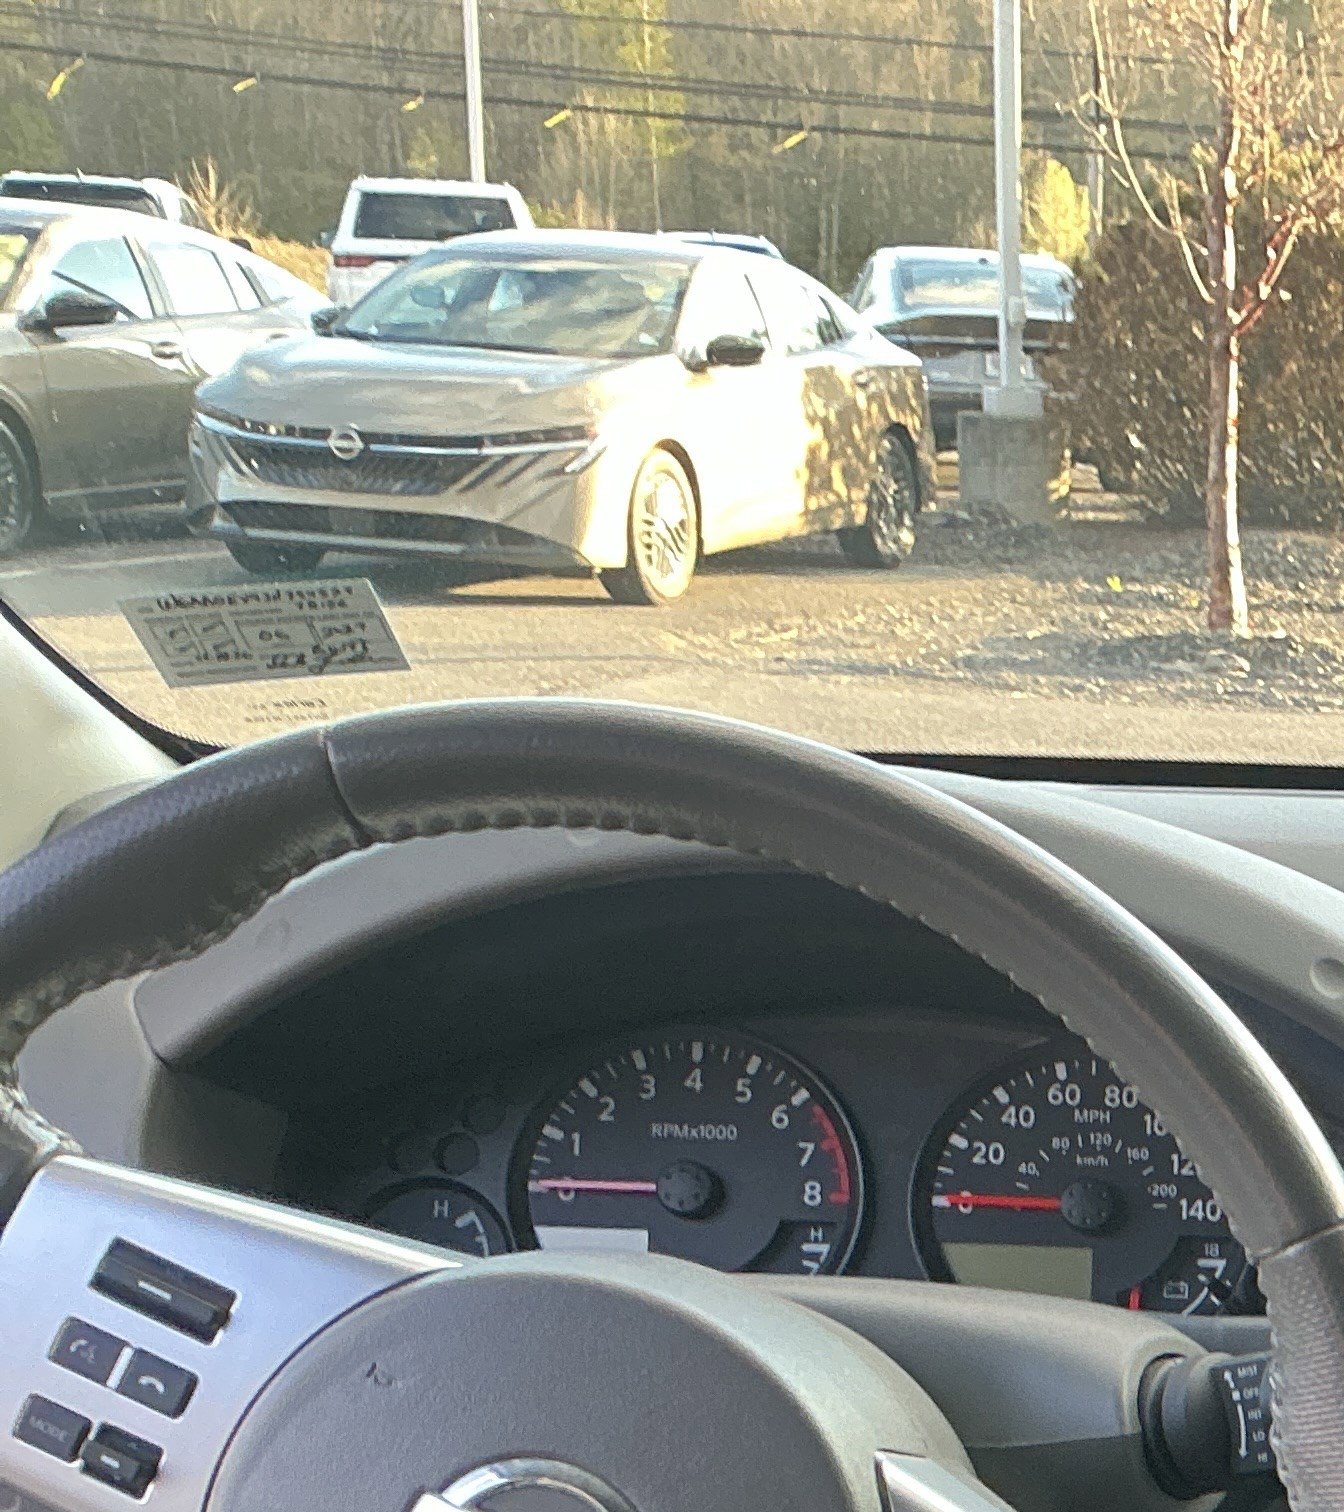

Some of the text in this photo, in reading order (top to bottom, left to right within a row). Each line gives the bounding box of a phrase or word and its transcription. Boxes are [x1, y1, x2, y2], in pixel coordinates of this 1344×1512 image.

[639, 1075, 657, 1100] 3
[685, 1069, 704, 1093] 4
[735, 1078, 752, 1103] 5
[1047, 1083, 1081, 1107] 60
[1103, 1085, 1139, 1108] 80
[598, 1098, 616, 1122] 2
[771, 1104, 790, 1130] 6
[1000, 1104, 1035, 1130] 40
[1073, 1108, 1111, 1124] MPH
[650, 1122, 739, 1142] RPMx1000
[1051, 1136, 1071, 1151] 80
[1088, 1133, 1112, 1147] 120
[570, 1132, 581, 1157] 1
[797, 1141, 816, 1168] 7
[971, 1141, 1005, 1165] 20
[1017, 1161, 1036, 1176] 40
[803, 1180, 822, 1207] 8
[1151, 1184, 1178, 1198] 200
[432, 1199, 449, 1218] H
[1179, 1198, 1223, 1223] 140
[810, 1226, 823, 1241] H
